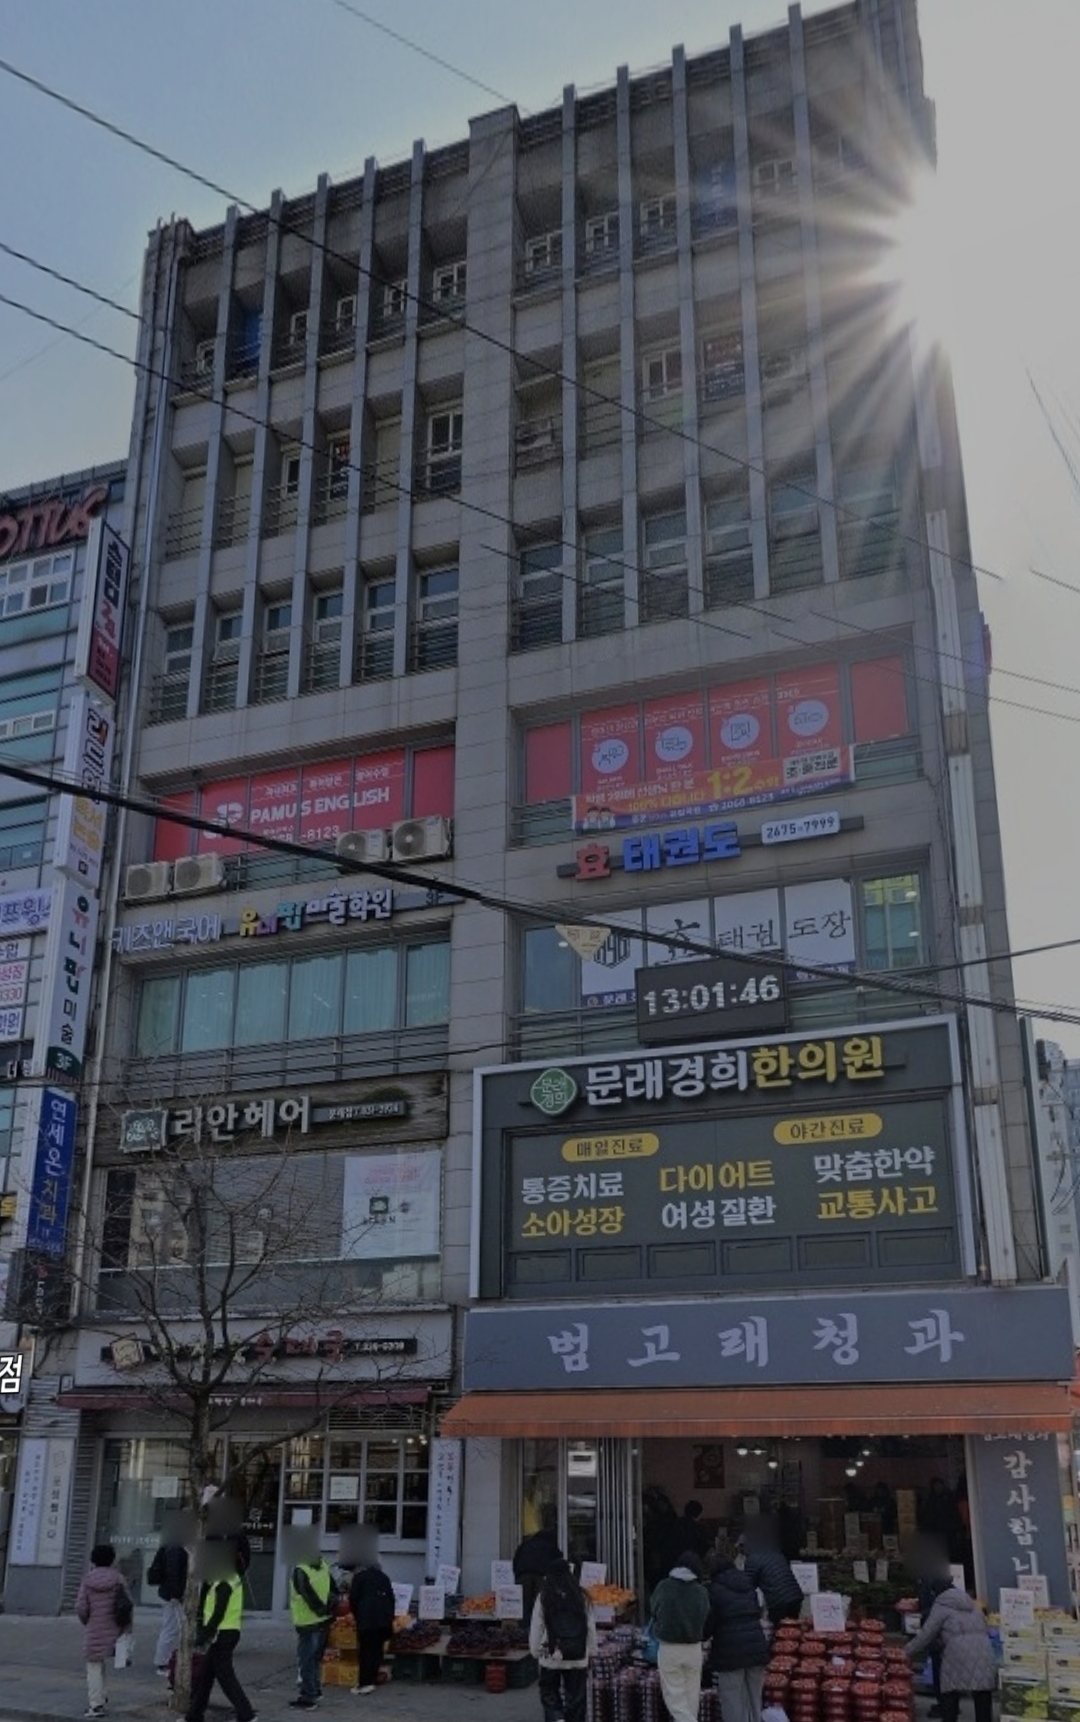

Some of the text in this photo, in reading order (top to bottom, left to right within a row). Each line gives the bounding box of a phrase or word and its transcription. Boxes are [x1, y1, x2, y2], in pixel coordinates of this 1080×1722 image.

[314, 786, 390, 815] ENGLISH
[766, 815, 835, 840] 2675-7999
[575, 821, 742, 881] 효 태권도
[643, 974, 781, 1017] 13:01:46
[171, 1094, 310, 1144] 리안헤어
[789, 1116, 866, 1140] 야간진료
[576, 1136, 644, 1158] 매일진료
[813, 1145, 936, 1184] 맞춤한약
[521, 1171, 625, 1205] 통증치료
[659, 1159, 776, 1194] 다이어트
[661, 1196, 777, 1231] 여성질환
[816, 1185, 939, 1220] 교통사고
[521, 1205, 626, 1238] 소아성장
